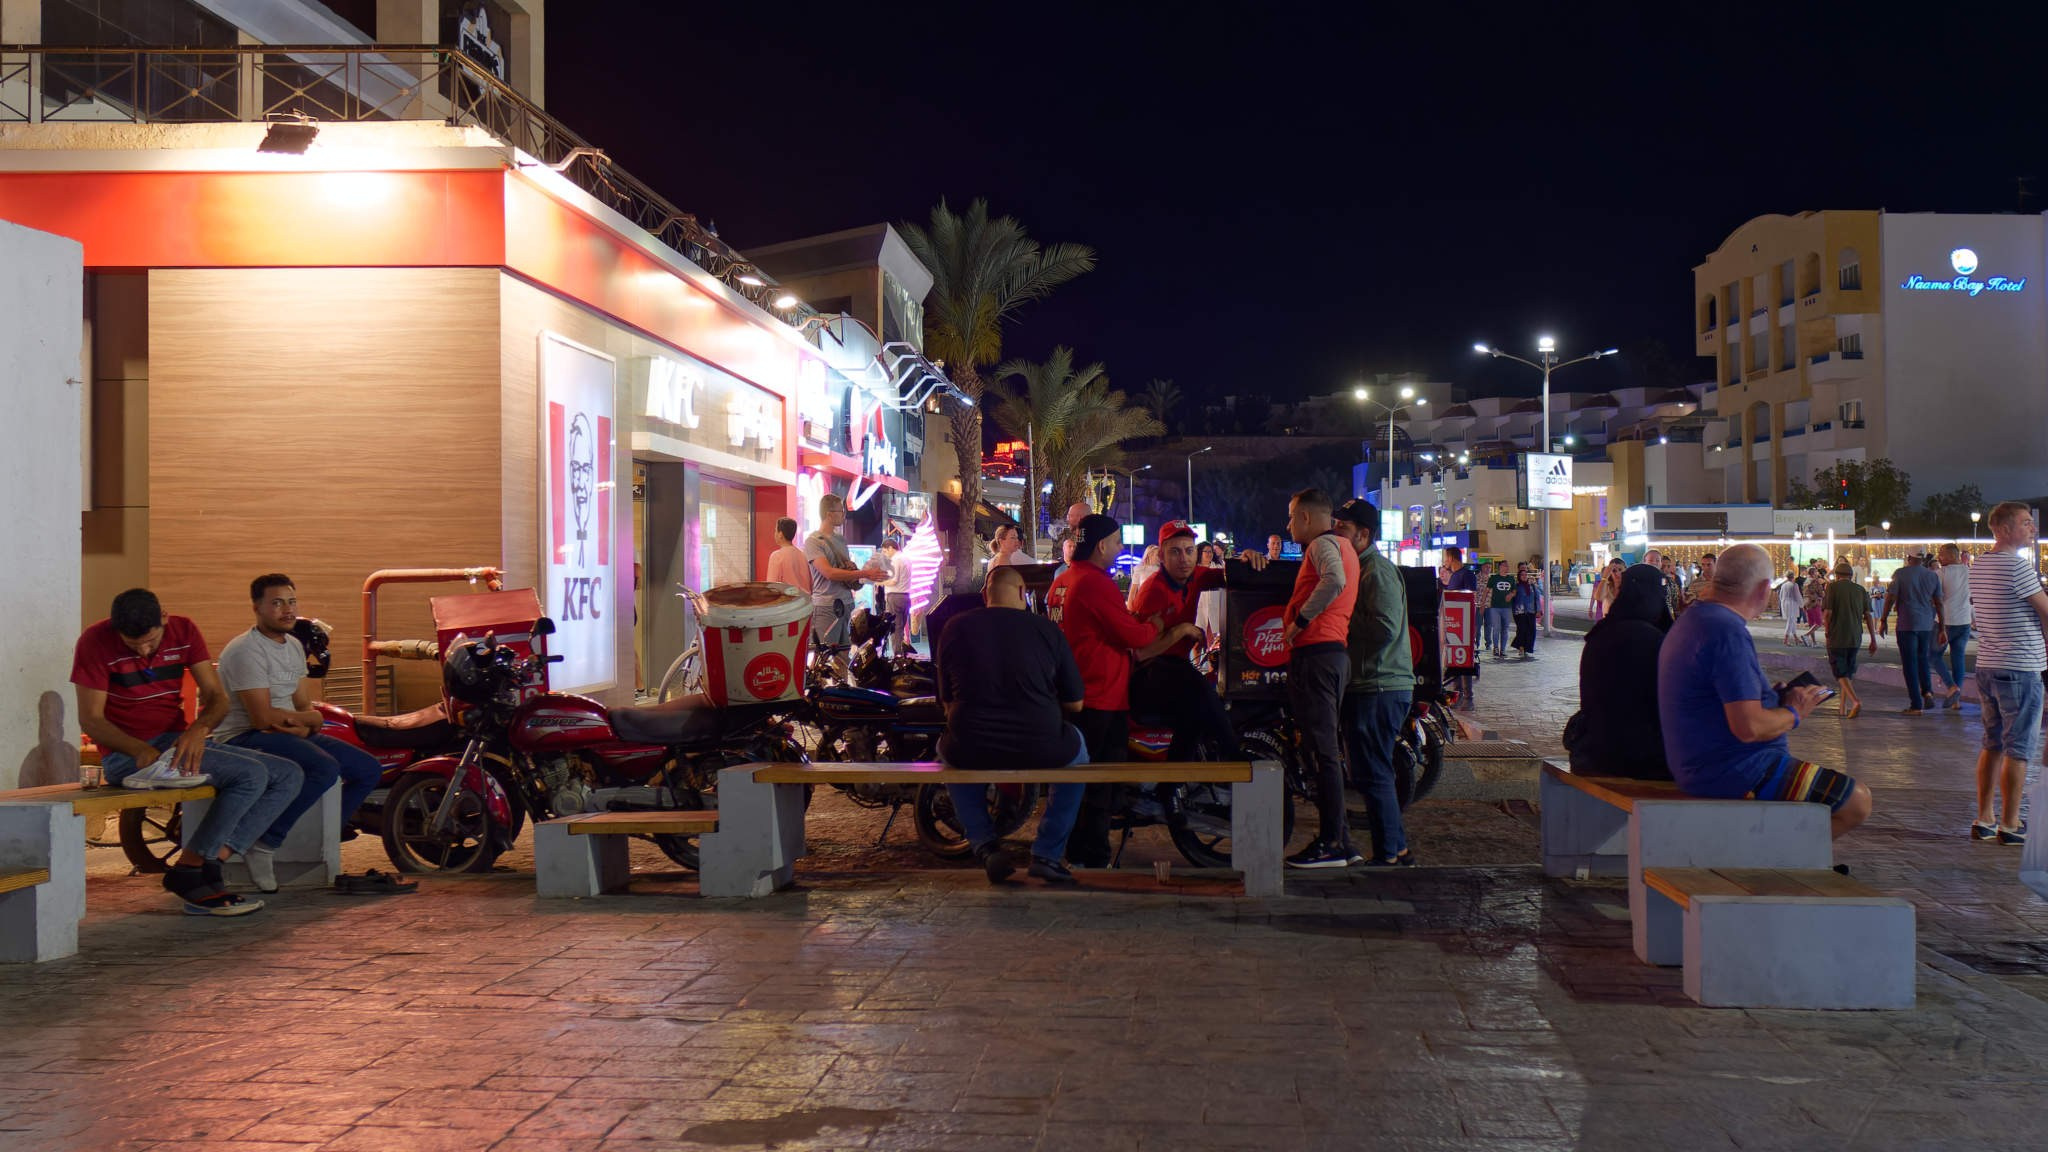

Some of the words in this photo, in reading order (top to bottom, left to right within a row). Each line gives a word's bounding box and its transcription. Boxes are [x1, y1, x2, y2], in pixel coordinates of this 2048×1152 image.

[1902, 276, 1951, 290] Naama
[1952, 276, 1984, 296] Bay
[1986, 277, 2024, 291] Hotel
[648, 356, 703, 429] KFC
[1545, 476, 1572, 485] adidas
[562, 576, 602, 621] KFC
[1254, 630, 1285, 647] Pizz
[1447, 647, 1467, 665] 19
